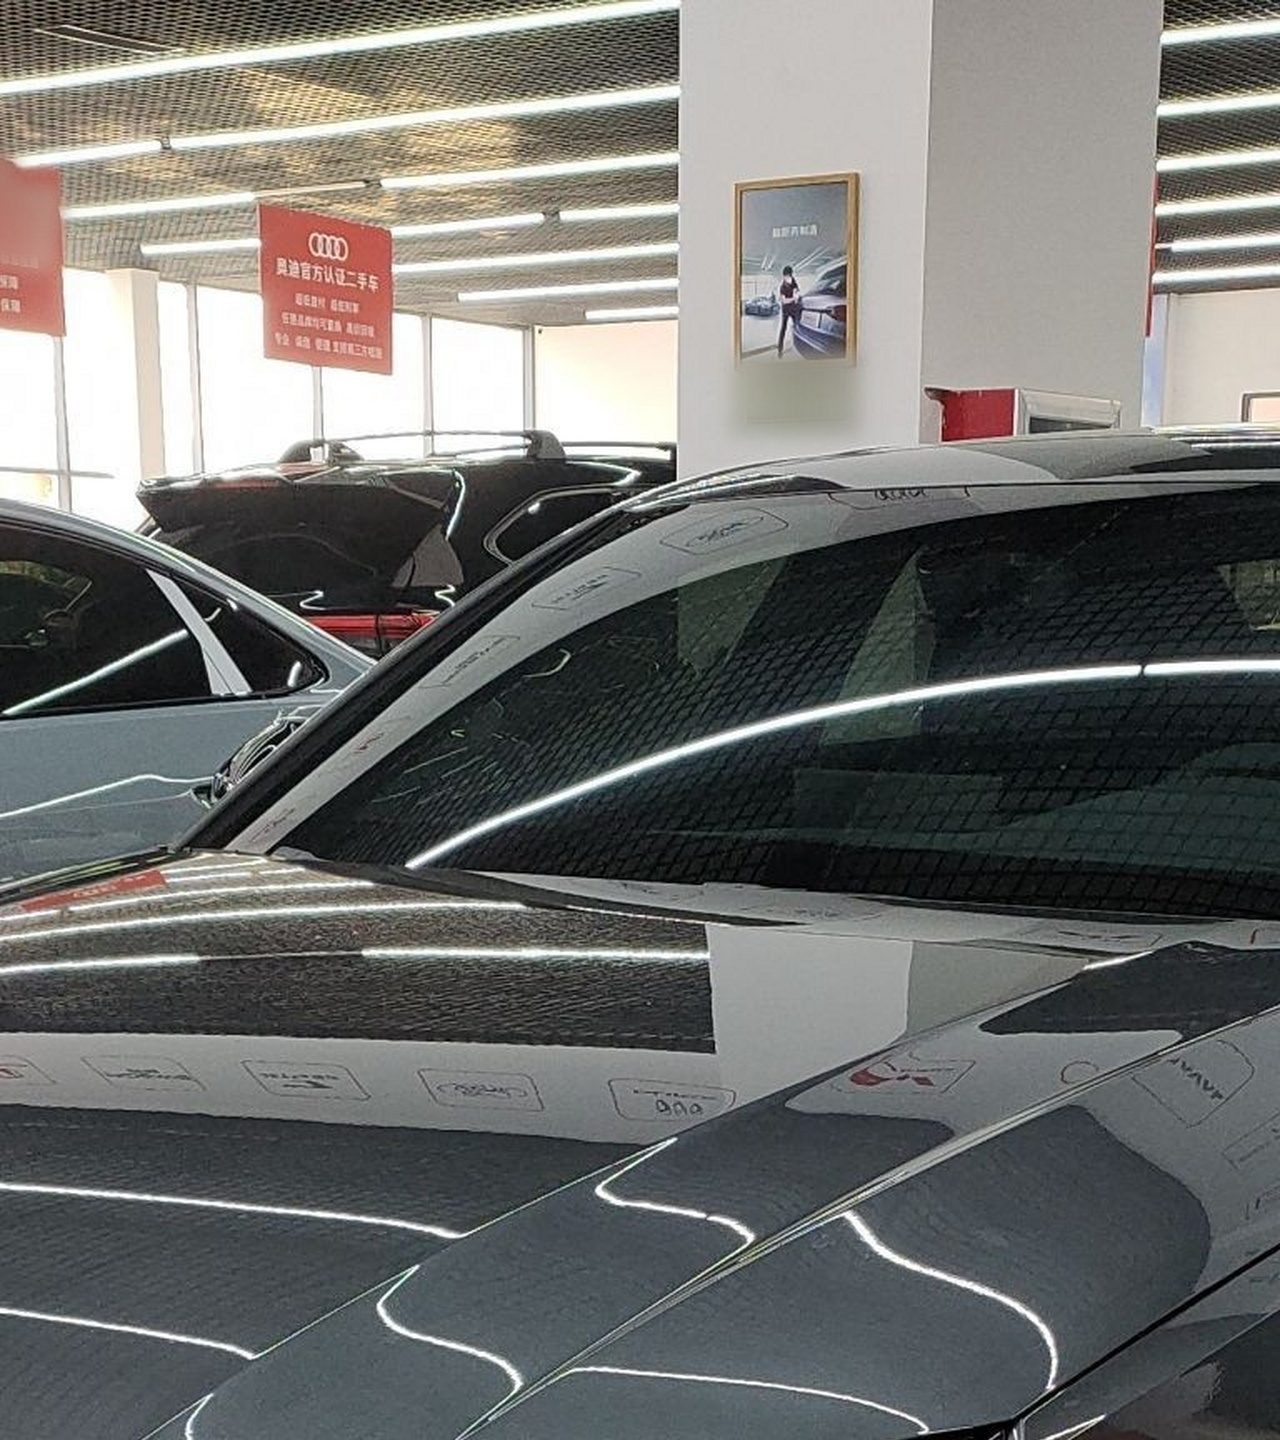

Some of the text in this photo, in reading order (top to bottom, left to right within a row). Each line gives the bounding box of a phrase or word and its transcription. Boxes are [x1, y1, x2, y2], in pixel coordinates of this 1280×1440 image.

[276, 257, 380, 293] 奥迪官方认证二手车
